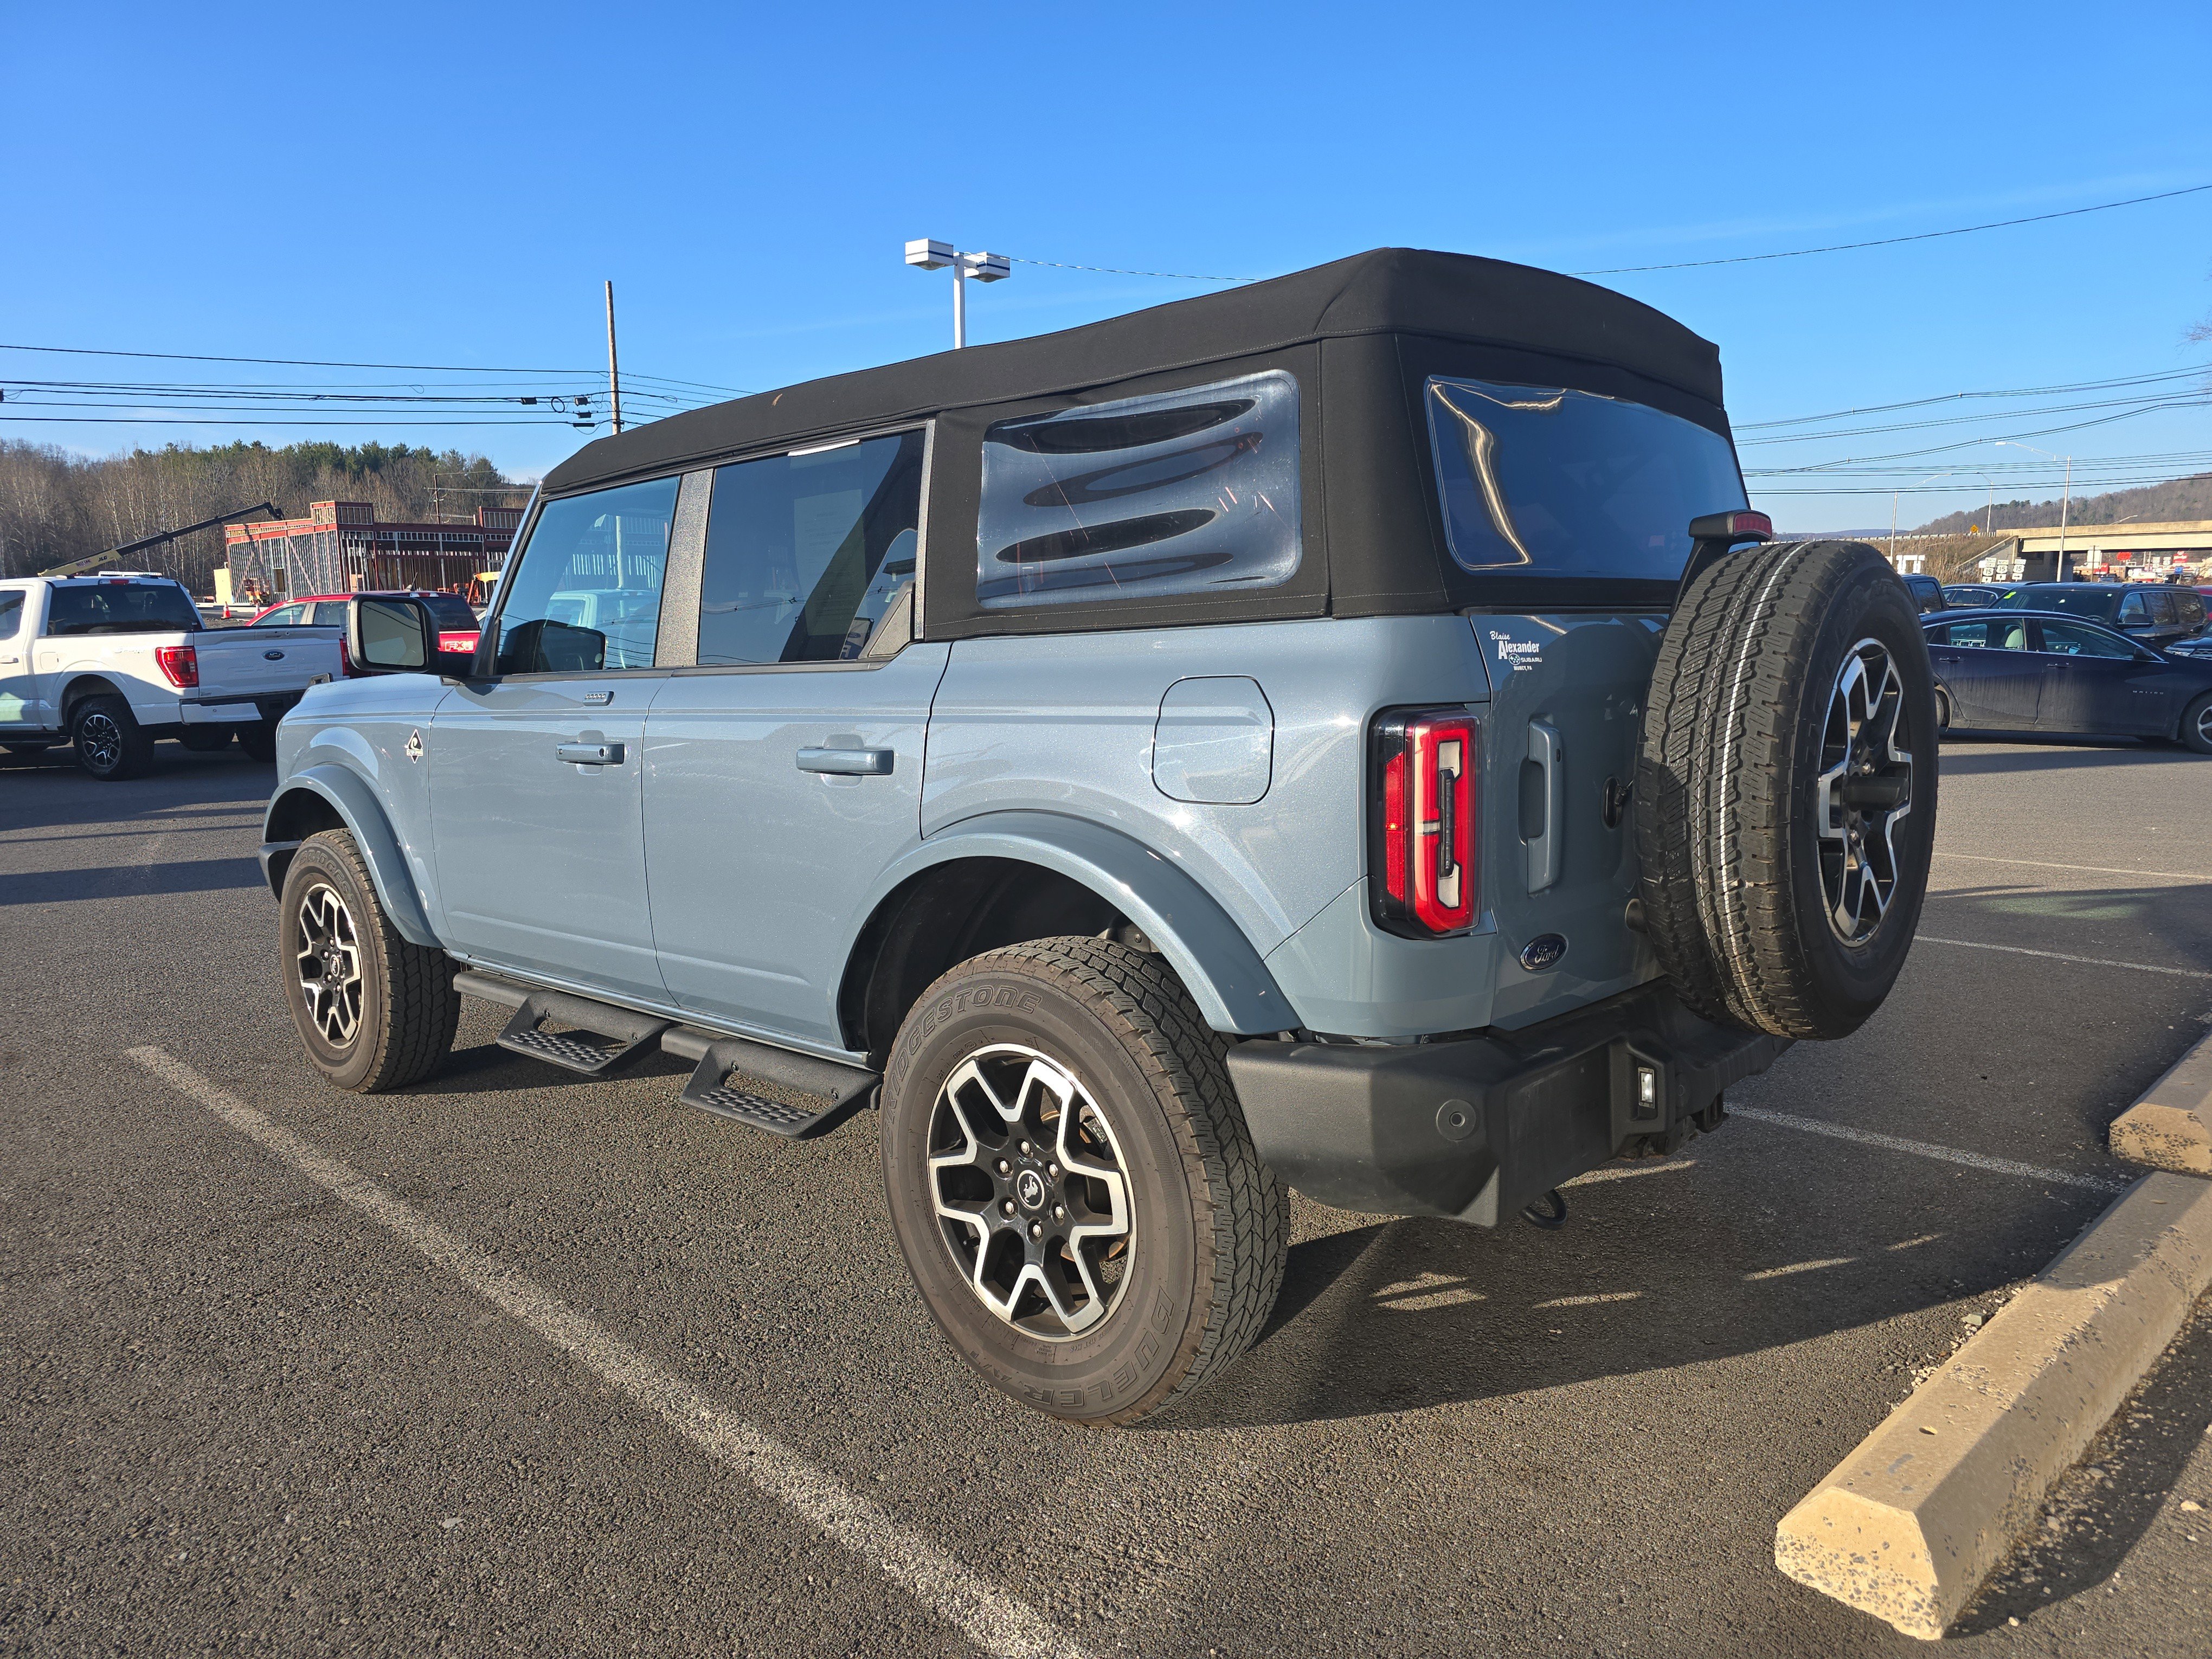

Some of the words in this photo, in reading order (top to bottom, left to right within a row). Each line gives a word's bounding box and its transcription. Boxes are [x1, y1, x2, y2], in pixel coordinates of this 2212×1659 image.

[1489, 631, 1511, 640] Blaise
[1498, 640, 1540, 660] Alexander
[1534, 944, 1560, 964] Ford
[882, 985, 1043, 1160] BRIDGESTONE
[1024, 1285, 1175, 1407] DUELER
